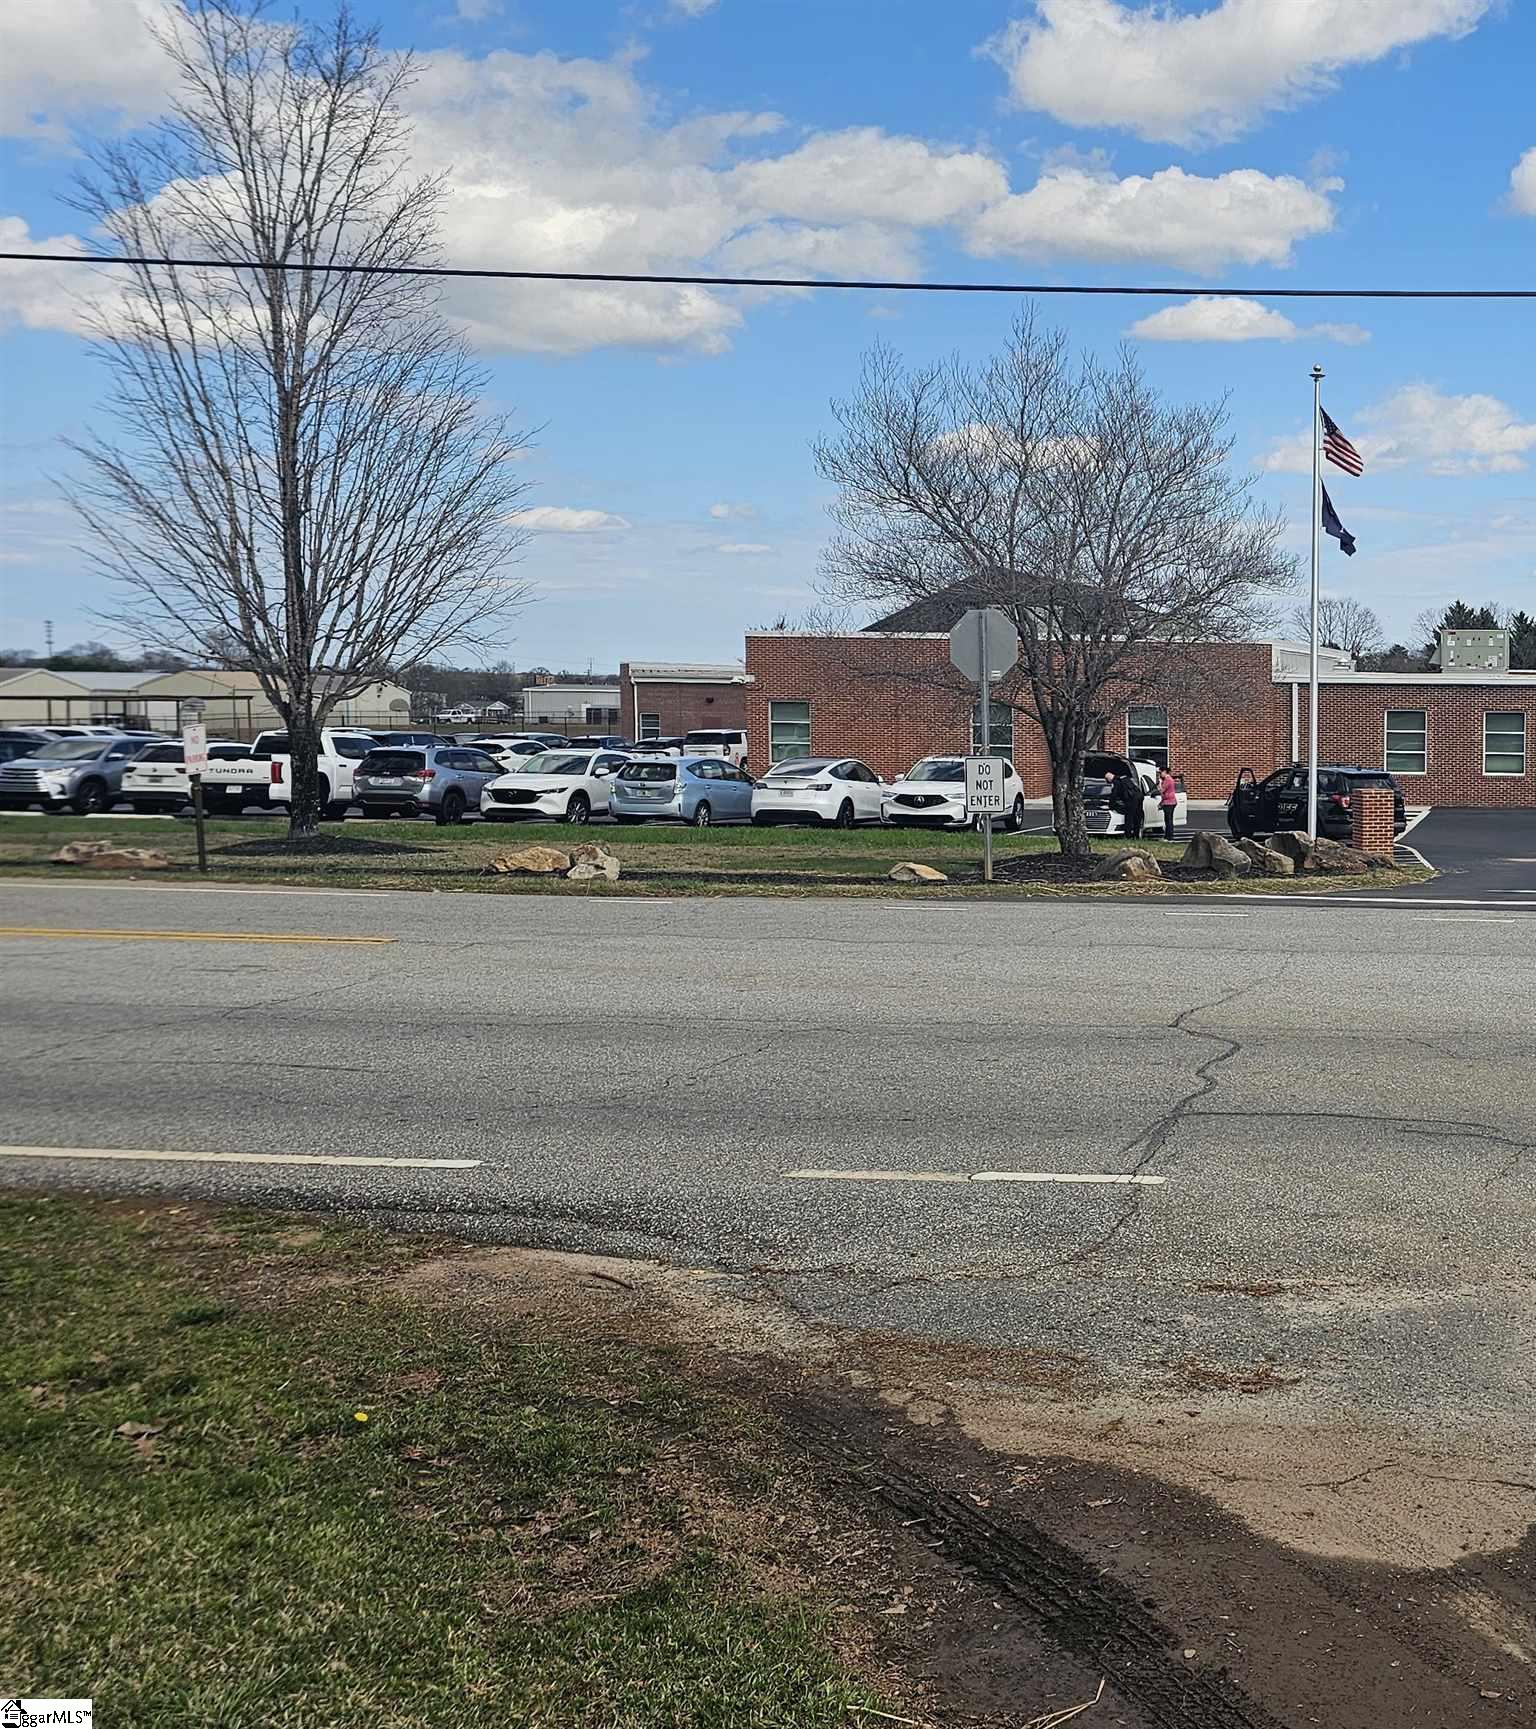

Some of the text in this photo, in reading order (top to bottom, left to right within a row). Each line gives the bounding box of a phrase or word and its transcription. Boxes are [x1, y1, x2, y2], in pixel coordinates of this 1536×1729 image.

[978, 764, 991, 775] DO
[975, 779, 994, 791] NOT
[970, 795, 1000, 807] ENTER
